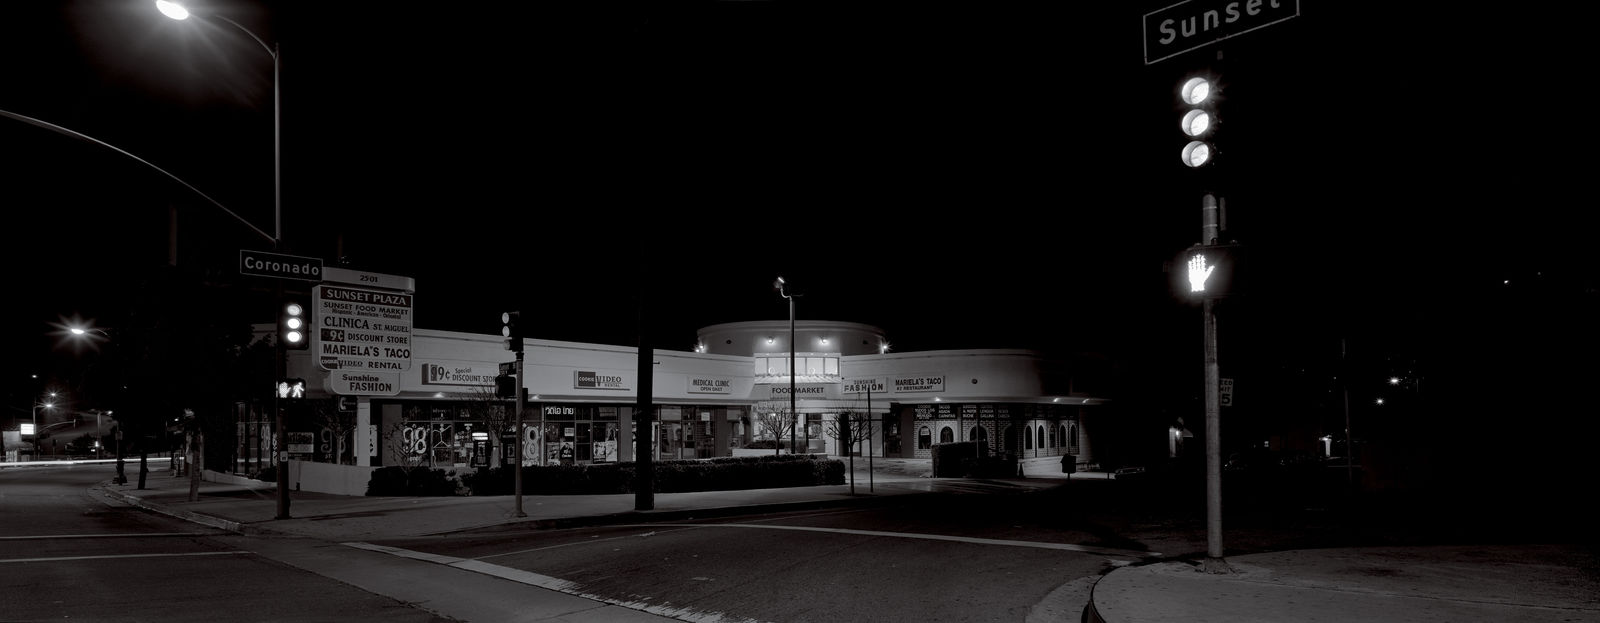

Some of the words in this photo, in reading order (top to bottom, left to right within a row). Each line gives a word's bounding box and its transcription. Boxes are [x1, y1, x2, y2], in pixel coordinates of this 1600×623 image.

[244, 256, 320, 276] Coronado
[360, 275, 378, 283] 2501
[326, 289, 370, 302] SUNSET
[373, 294, 407, 306] PLAZA
[323, 302, 353, 311] SUNSET
[355, 304, 377, 312] FOOD
[378, 306, 408, 315] MARKET
[324, 316, 370, 330] CLINICA
[384, 325, 409, 333] MIGUEL
[348, 333, 384, 343] DISCOUNT
[386, 336, 408, 344] STORE
[323, 344, 380, 357] MARIELA'S
[384, 348, 410, 359] TACO
[338, 360, 363, 369] VIDEO
[368, 361, 403, 370] RENTAL
[342, 374, 380, 382] Sunshine
[452, 374, 481, 383] DISCOUNT
[482, 375, 496, 383] STOR
[596, 376, 622, 387] VIDEO
[715, 379, 730, 387] CLINIC
[895, 378, 924, 386] MARIELA'S
[926, 377, 942, 385] TACO
[349, 382, 392, 392] FASHION
[844, 384, 883, 392] FASHION
[403, 427, 427, 454] 98
